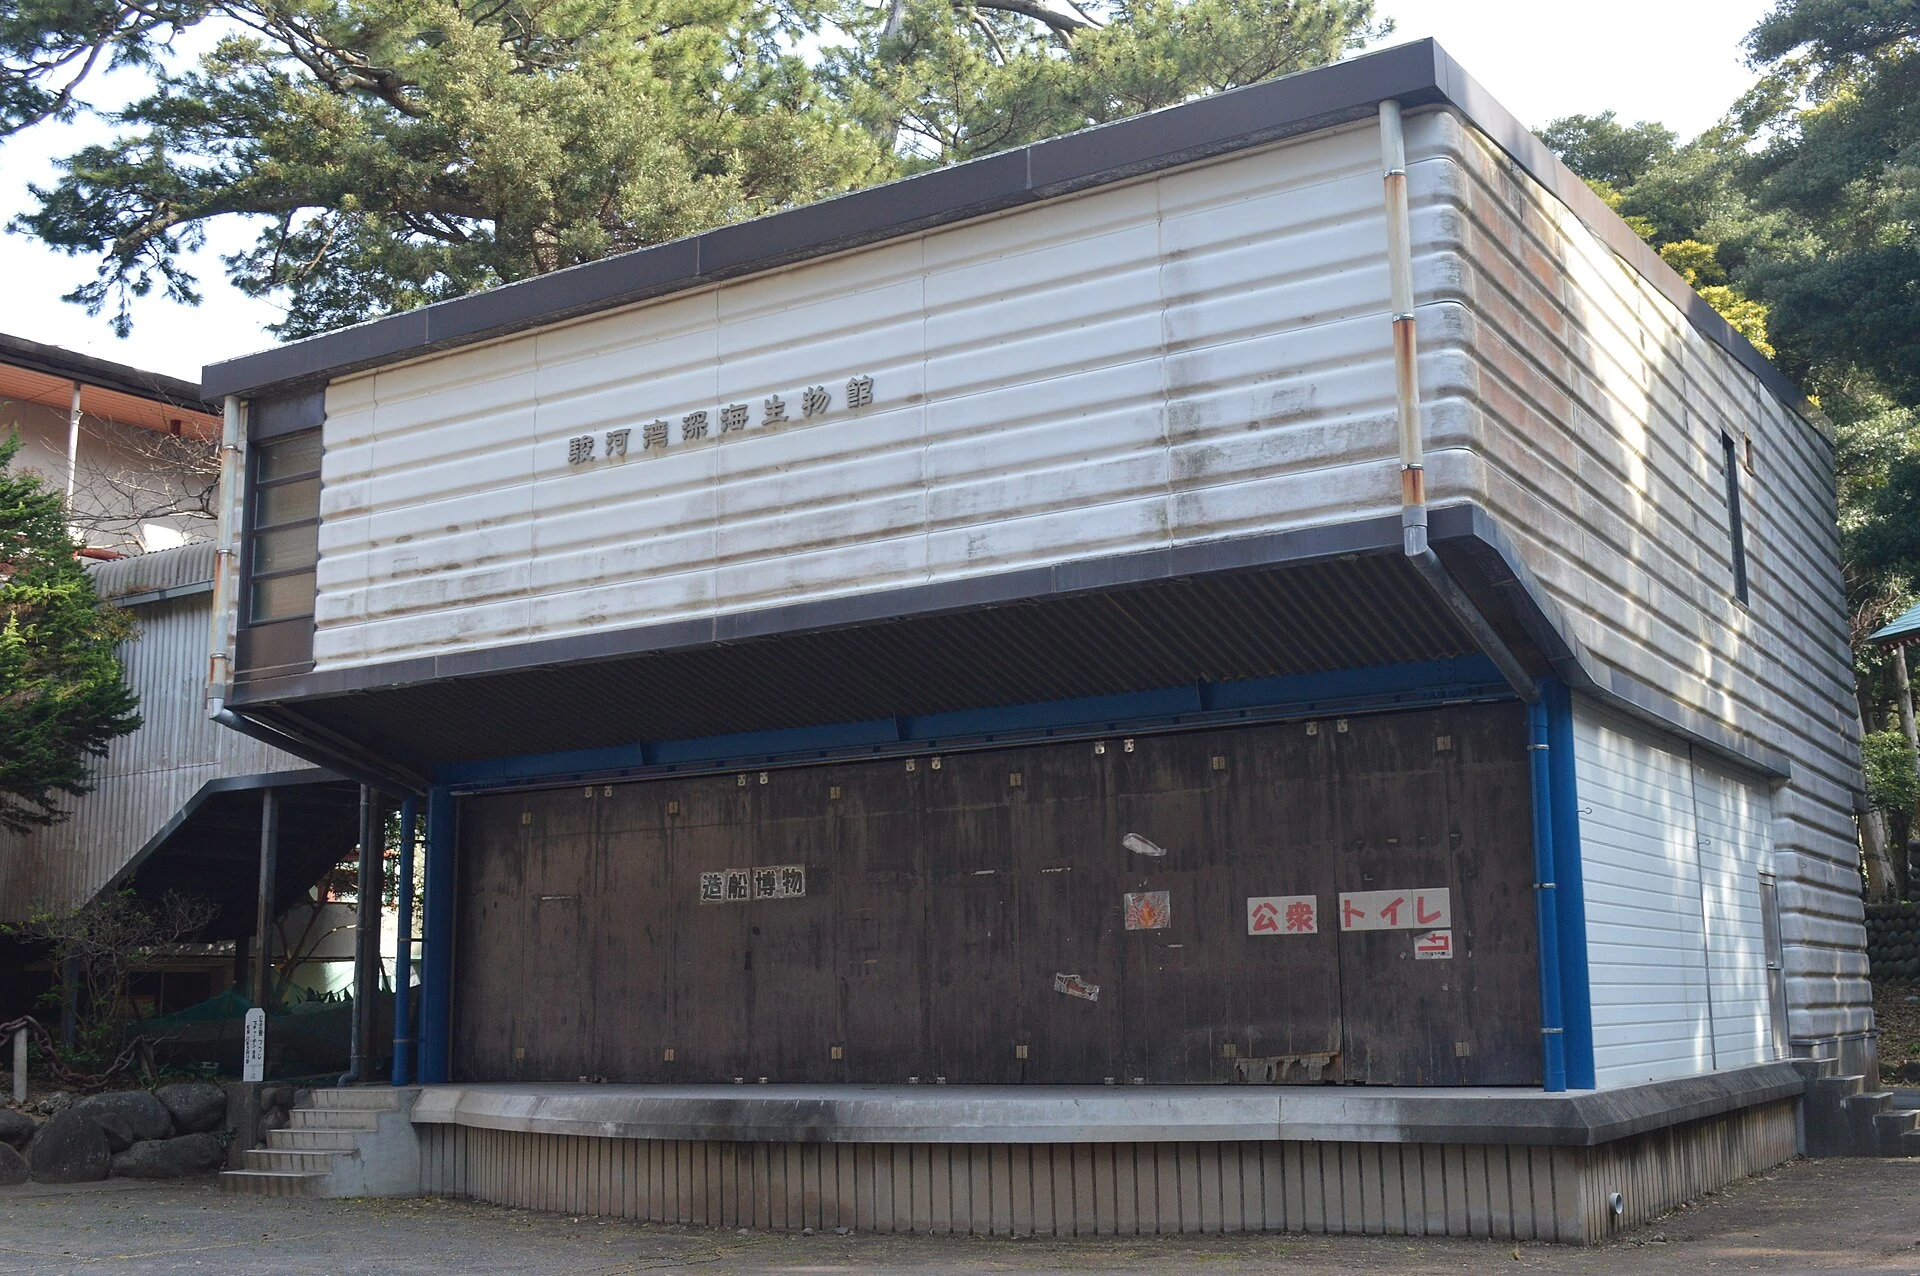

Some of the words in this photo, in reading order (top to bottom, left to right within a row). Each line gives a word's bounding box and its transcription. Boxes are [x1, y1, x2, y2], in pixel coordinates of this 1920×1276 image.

[568, 375, 874, 465] 駿河湾深海生物館
[702, 867, 803, 899] 造船博物
[1252, 901, 1314, 932] 公衆
[1344, 896, 1442, 928] トイレ
